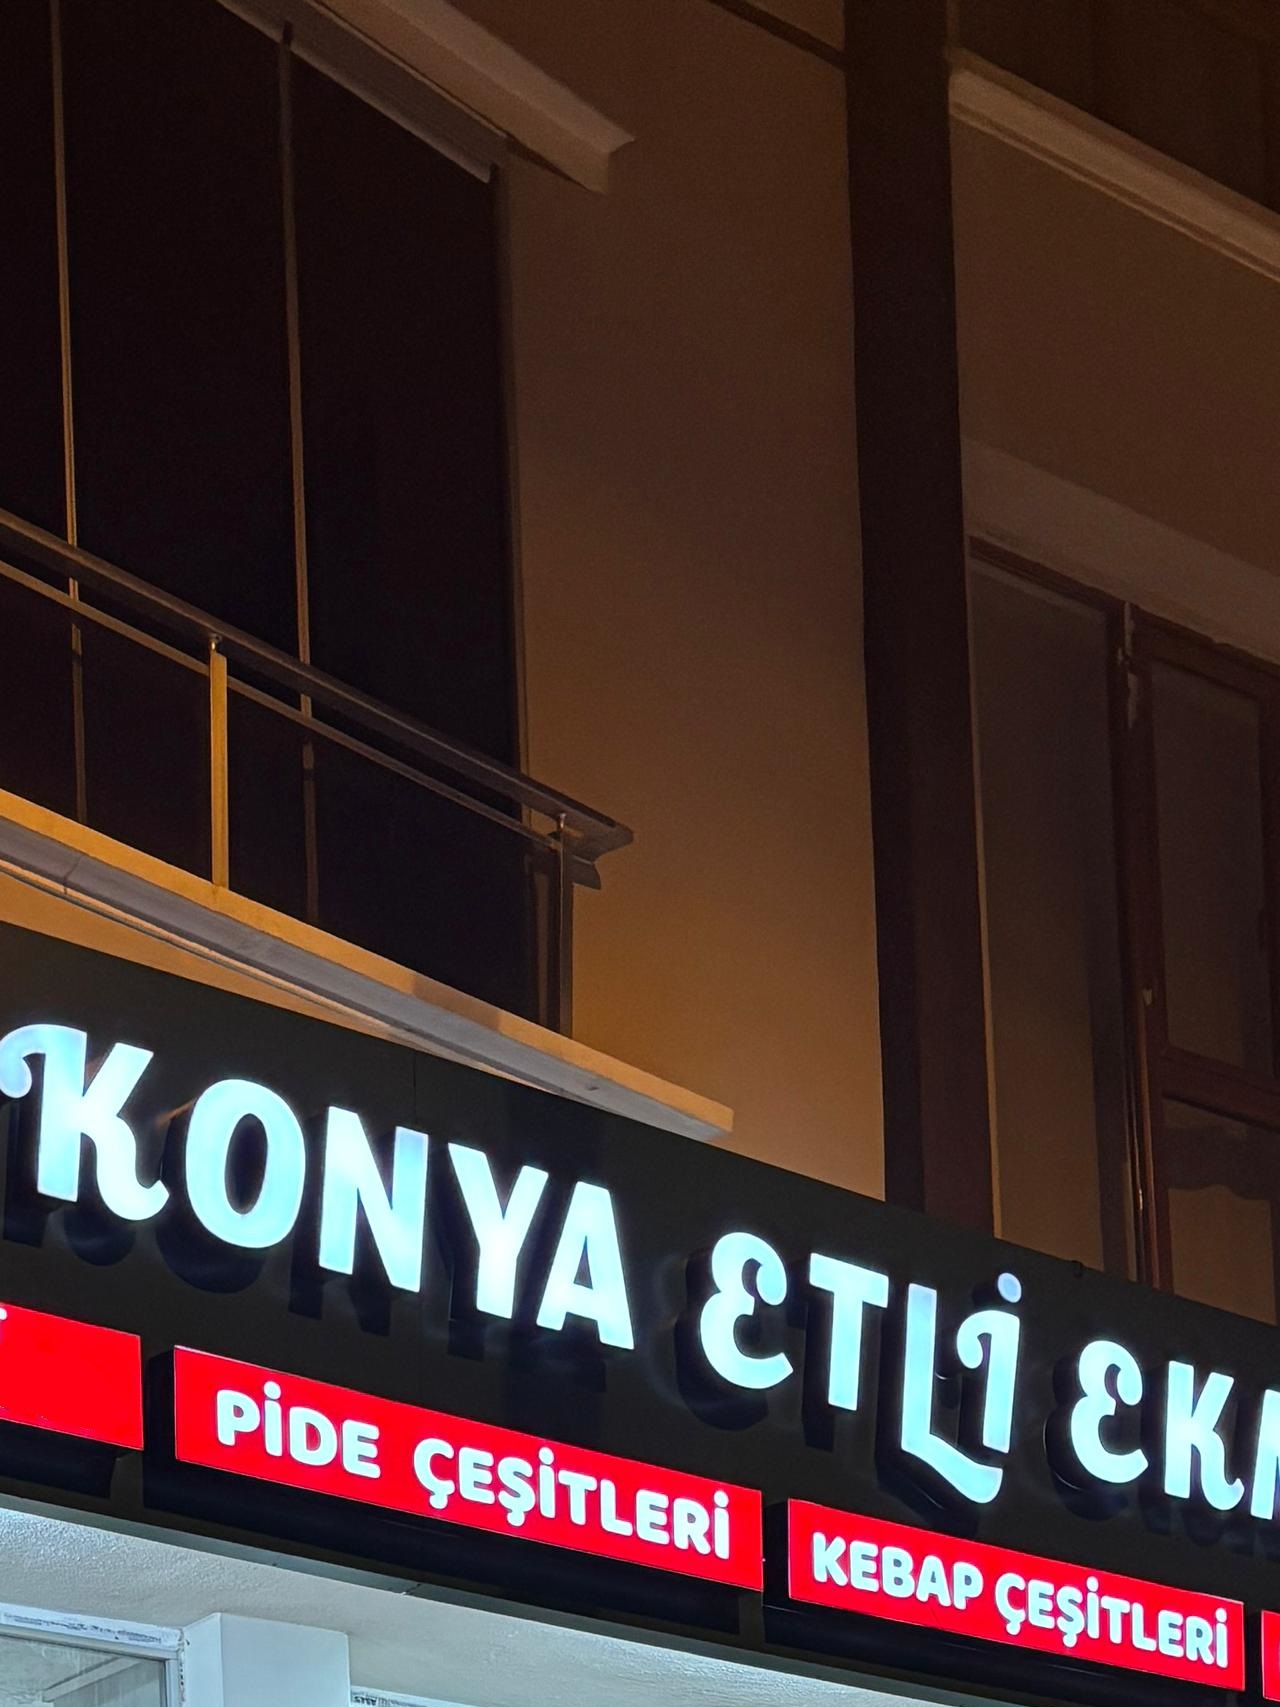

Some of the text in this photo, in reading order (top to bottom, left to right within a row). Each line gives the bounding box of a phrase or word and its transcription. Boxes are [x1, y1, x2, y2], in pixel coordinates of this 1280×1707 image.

[699, 1230, 1023, 1505] ETLİ
[215, 1379, 732, 1561] PİDE ÇEŞİTLERİ
[812, 1531, 1230, 1669] KEBAP ÇEŞİTLERİ
